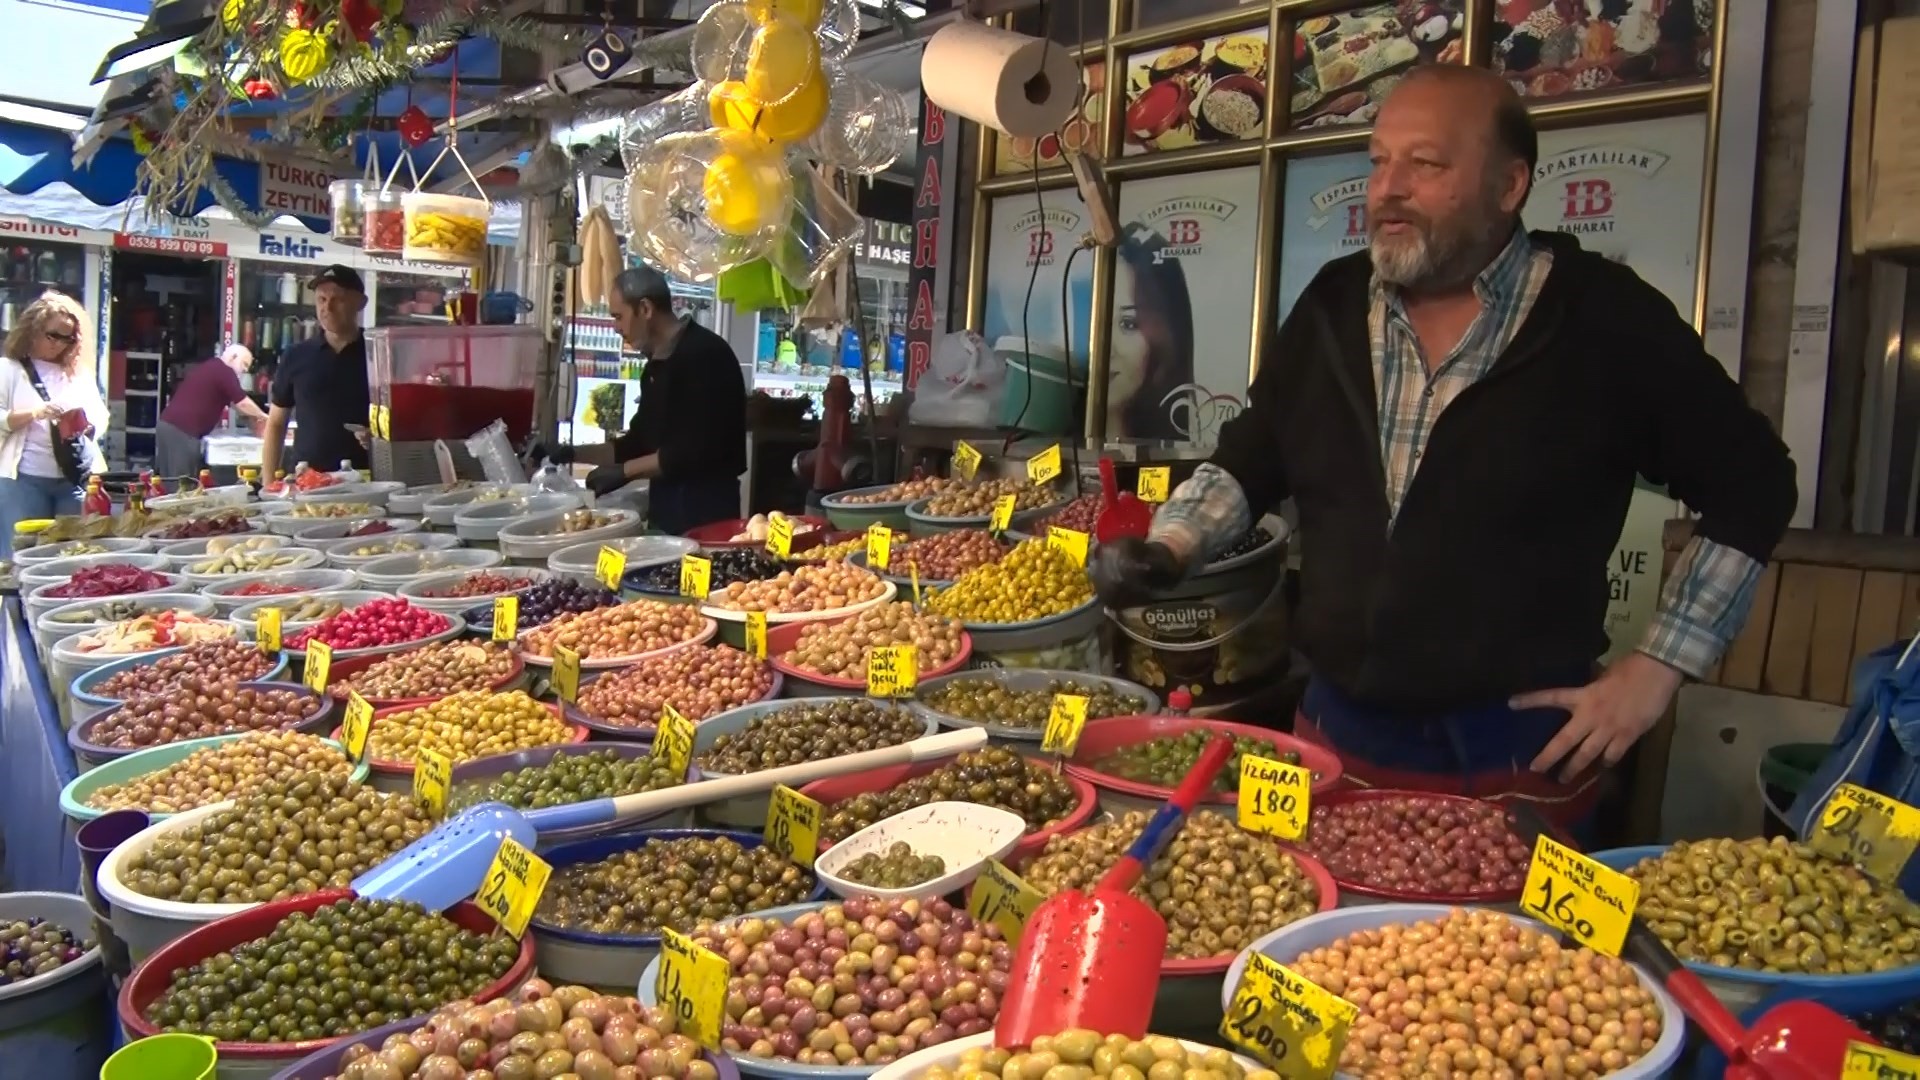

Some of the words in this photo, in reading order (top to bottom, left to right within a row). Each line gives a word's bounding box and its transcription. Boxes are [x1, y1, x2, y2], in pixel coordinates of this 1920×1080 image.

[1321, 181, 1368, 204] ISPART
[159, 239, 180, 251] 599
[199, 242, 214, 255] 09
[259, 234, 324, 259] Fakir
[1620, 550, 1648, 574] VE
[1251, 787, 1297, 816] 180
[1529, 876, 1594, 938] 160
[1230, 996, 1287, 1060] 200
